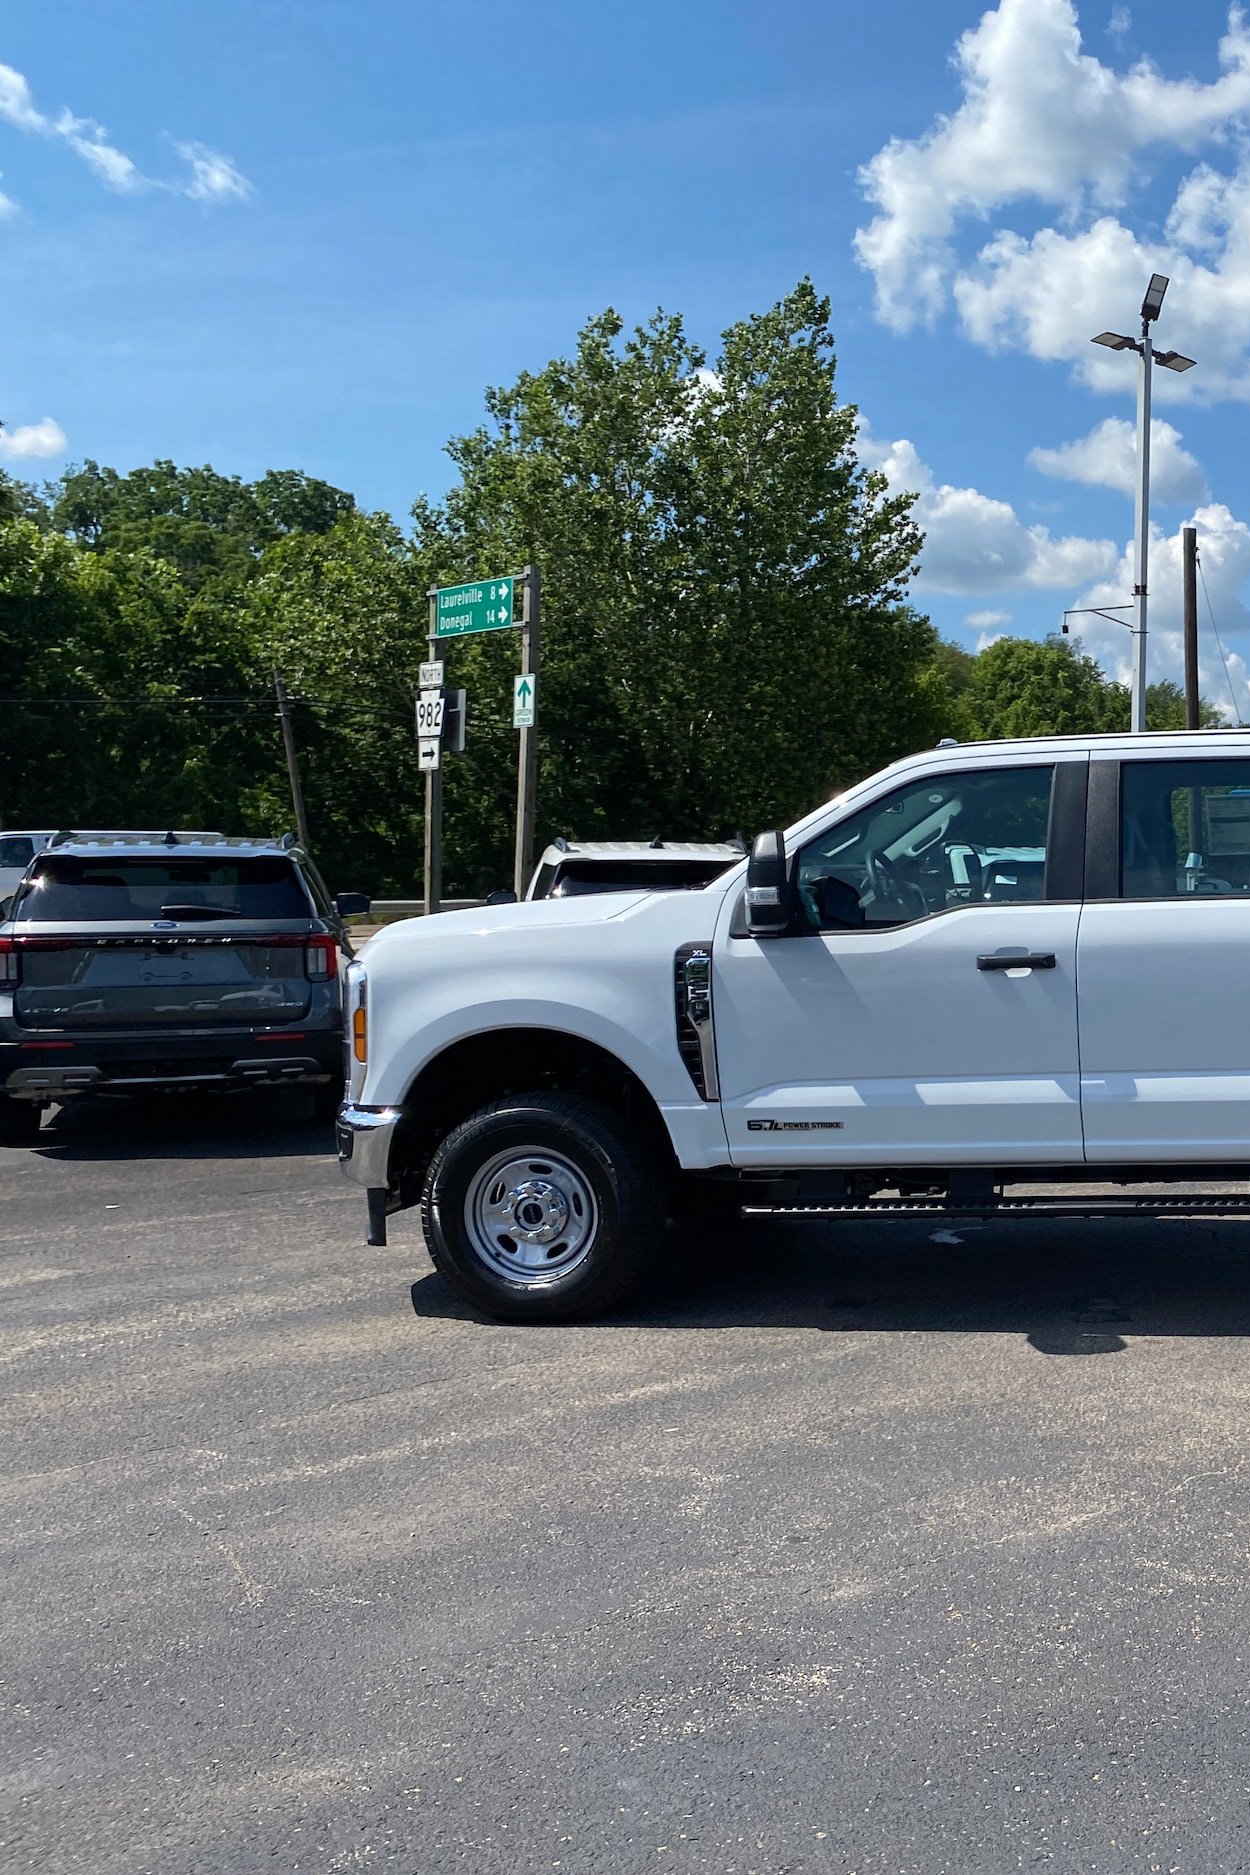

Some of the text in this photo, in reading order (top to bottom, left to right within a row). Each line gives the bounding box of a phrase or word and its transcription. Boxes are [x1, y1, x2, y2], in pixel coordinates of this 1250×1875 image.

[440, 585, 496, 609] Laurelville 8
[440, 609, 495, 631] Donegal 14
[422, 667, 442, 682] NORTH
[419, 702, 442, 728] 982
